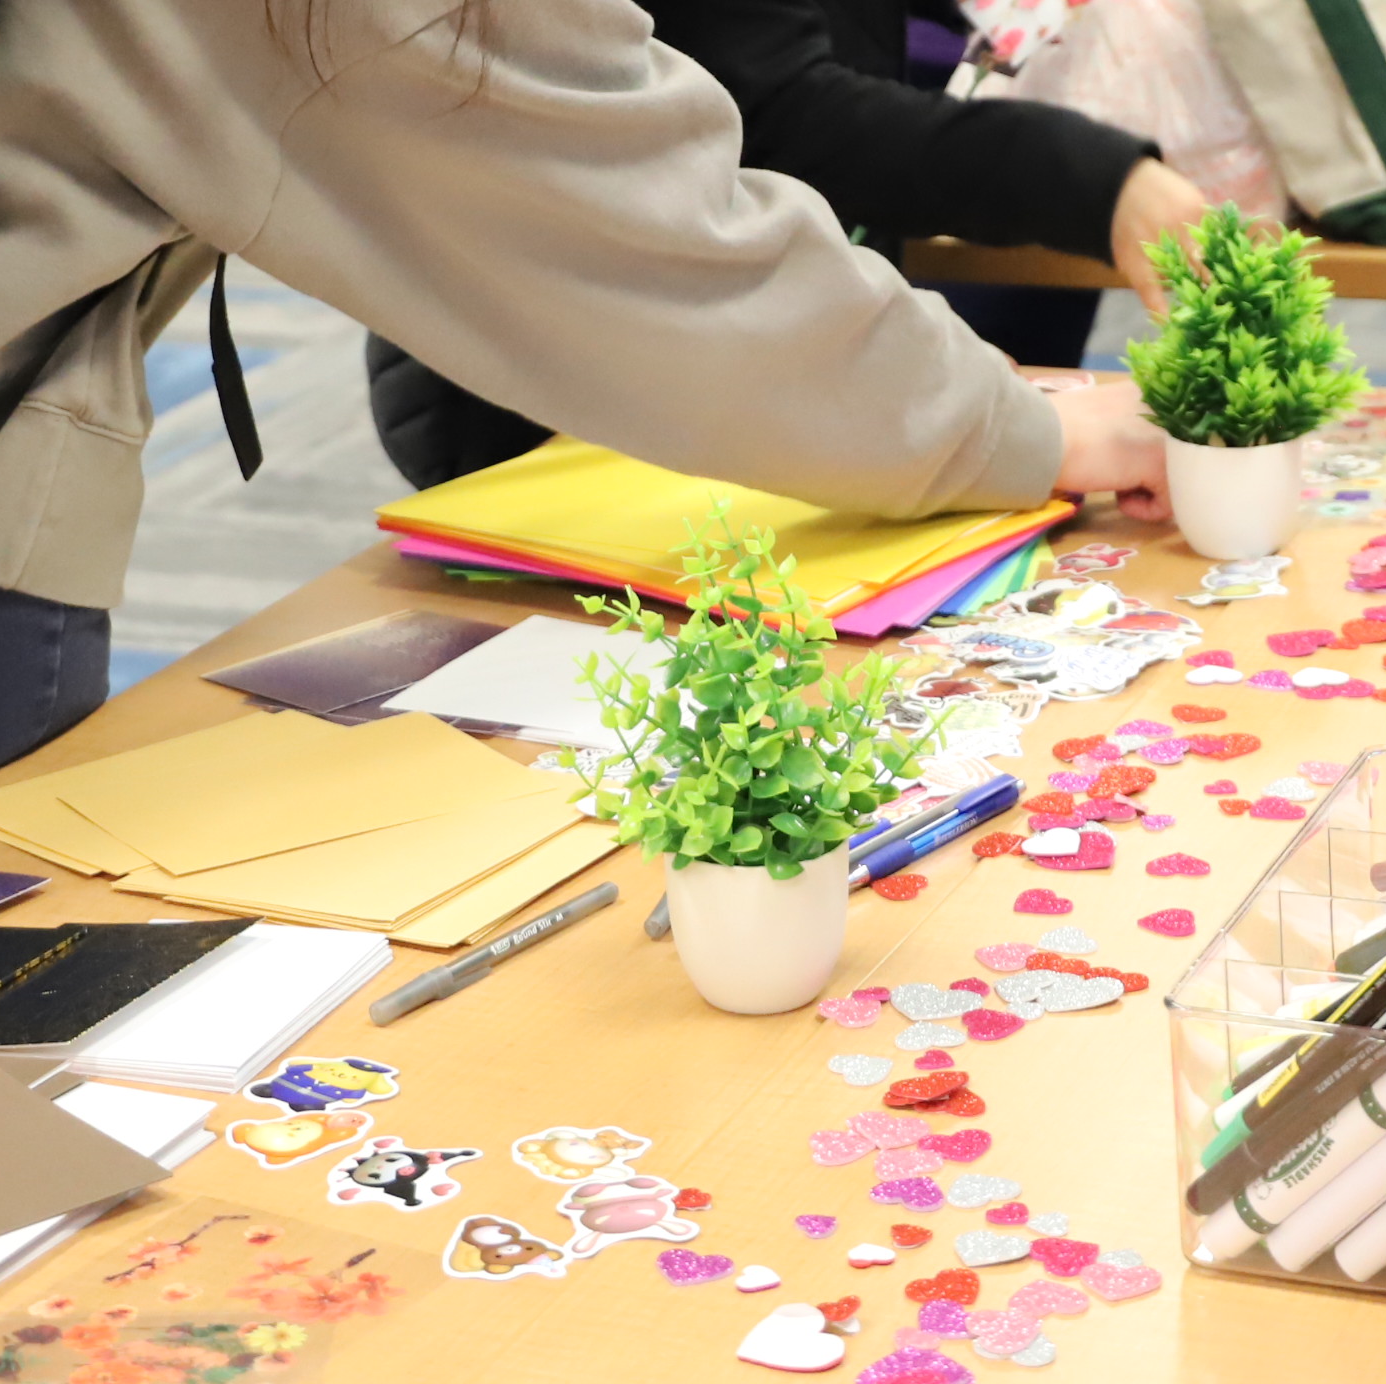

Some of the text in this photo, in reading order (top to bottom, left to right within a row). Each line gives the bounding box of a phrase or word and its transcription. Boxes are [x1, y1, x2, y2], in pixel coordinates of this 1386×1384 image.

[513, 924, 538, 944] Round
[537, 918, 552, 931] Stic
[555, 912, 564, 922] M
[1282, 1136, 1336, 1190] WASHABLE
